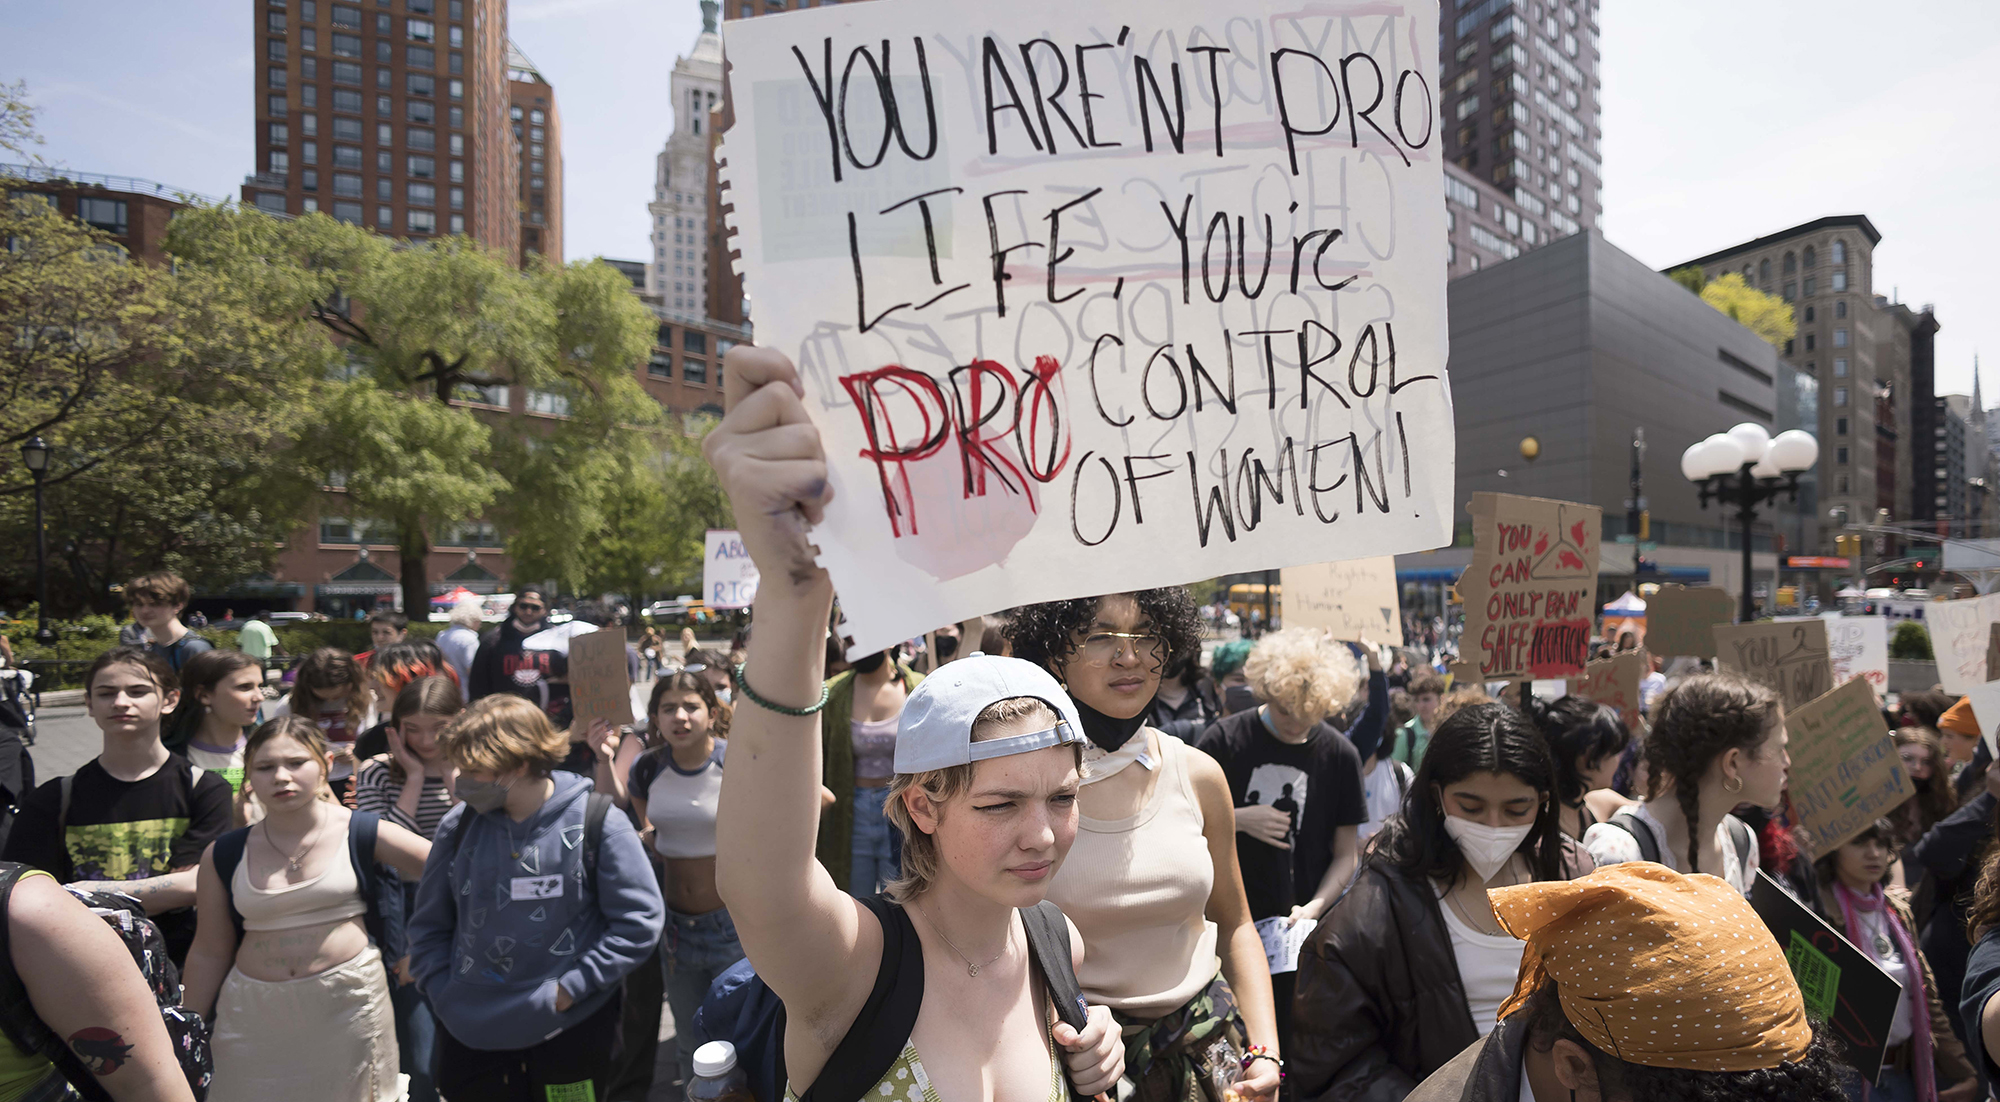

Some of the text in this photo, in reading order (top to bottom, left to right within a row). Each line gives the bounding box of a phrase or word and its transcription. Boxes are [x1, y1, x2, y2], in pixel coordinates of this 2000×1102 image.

[791, 36, 937, 183] YOU
[1270, 46, 1433, 176] PRO
[848, 187, 1124, 333] LIFE,
[838, 353, 1072, 538] PRO
[1090, 320, 1439, 427] CONTROL
[1070, 450, 1174, 546] OF
[1187, 411, 1420, 548] WOMEN!
[1498, 523, 1532, 555] YOU
[1489, 556, 1531, 588] CAN
[1487, 590, 1543, 621] ONLY
[1480, 621, 1591, 674] SAFE ABORTIONS
[1732, 635, 1779, 672] YOU
